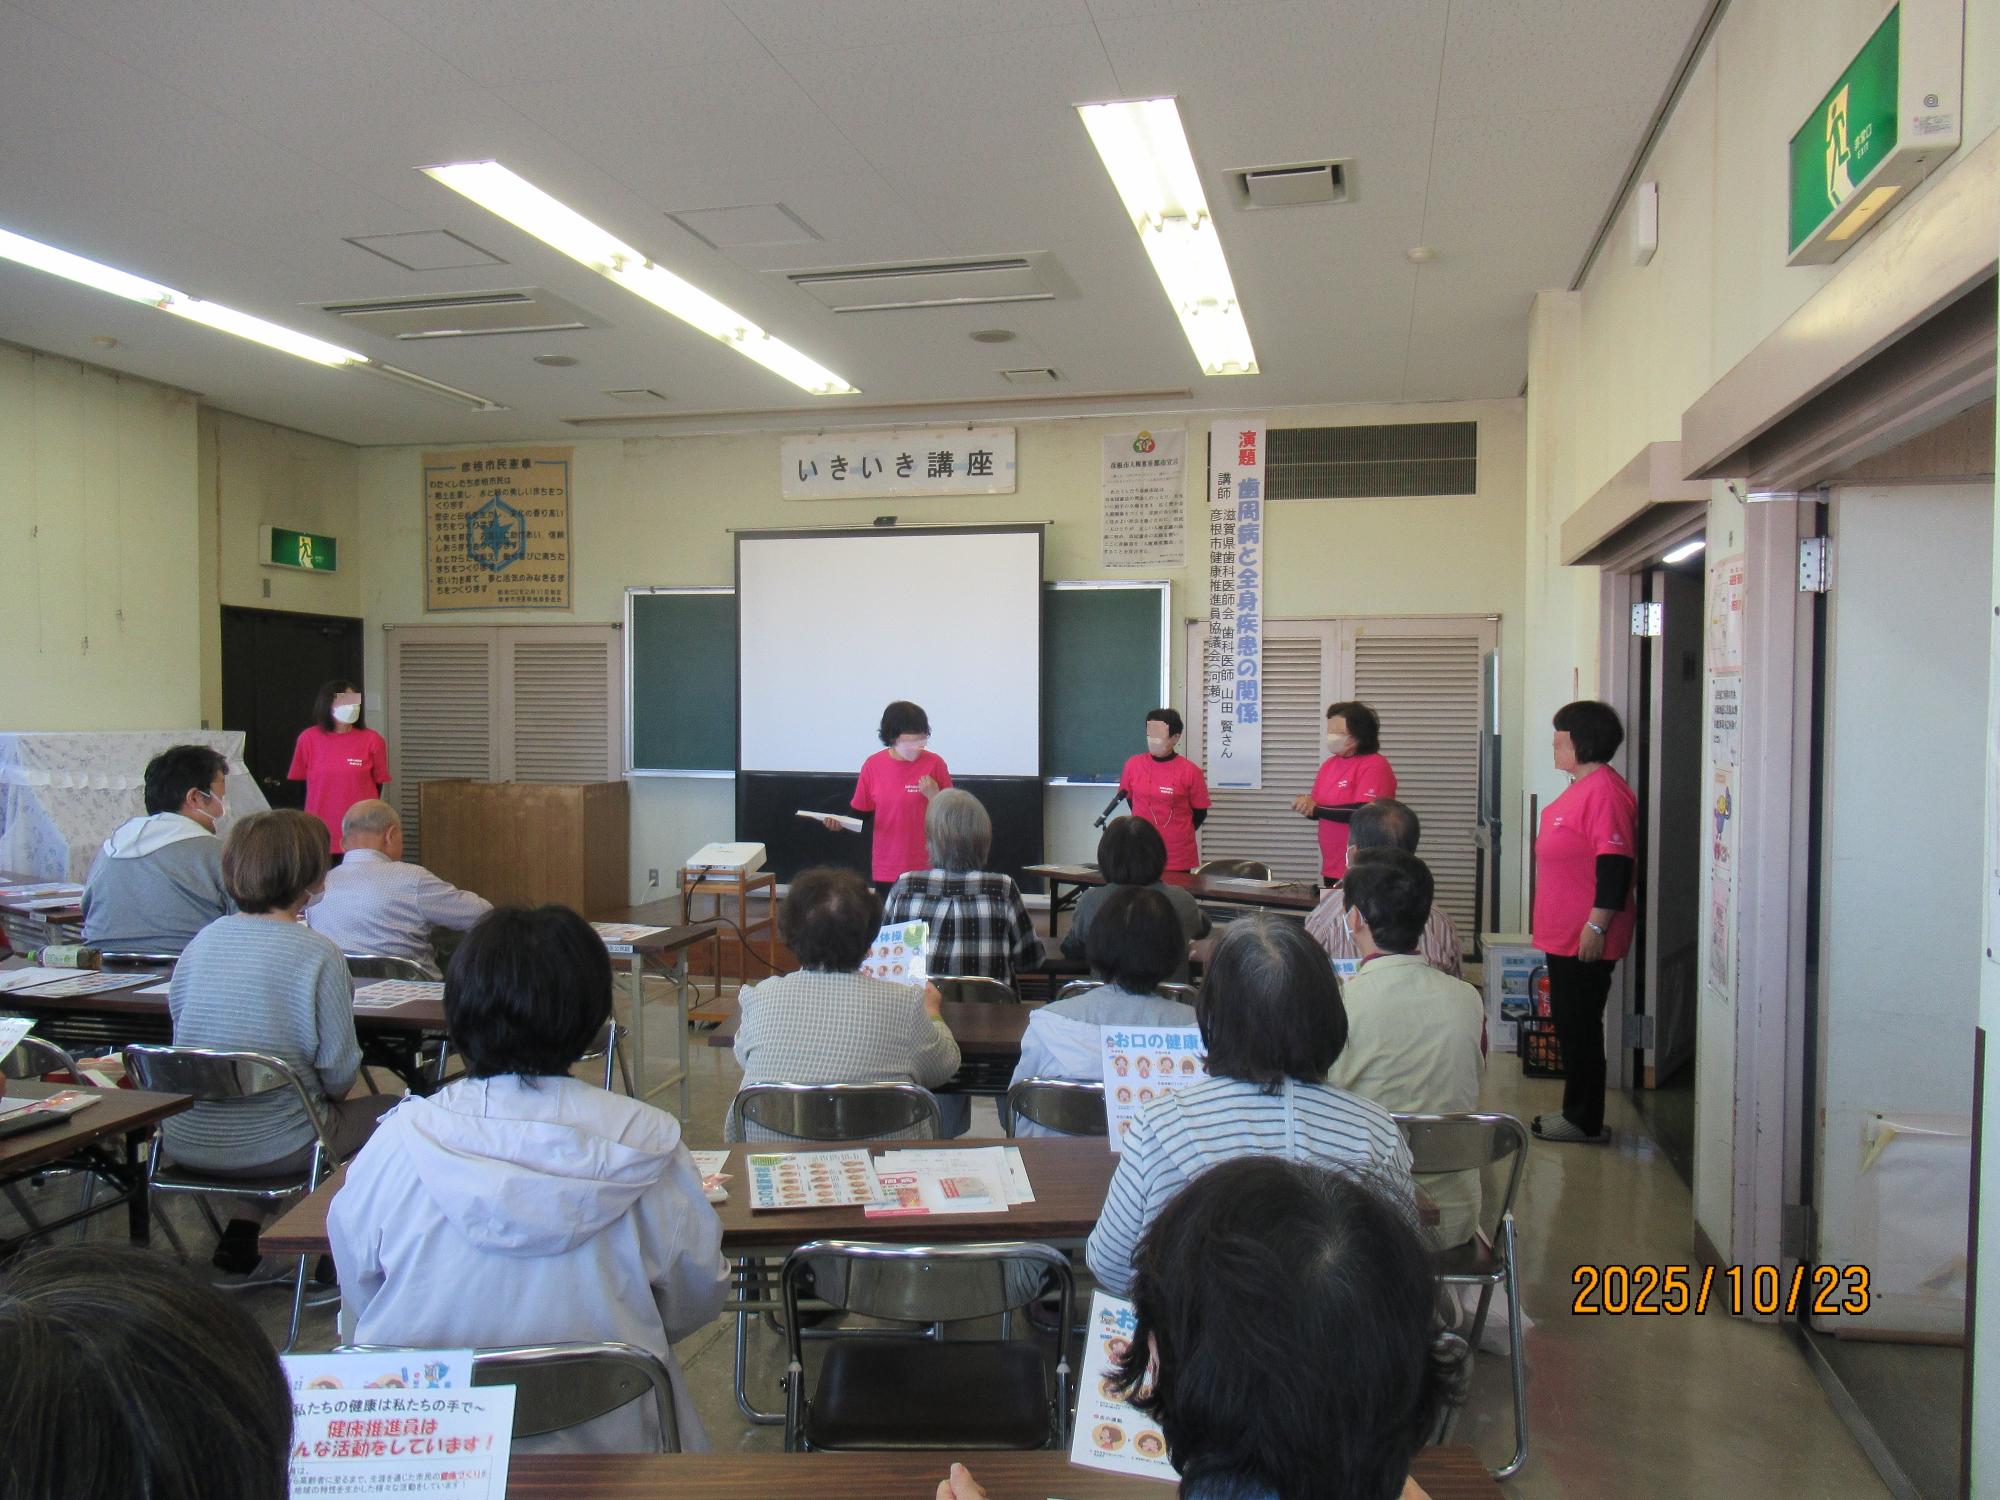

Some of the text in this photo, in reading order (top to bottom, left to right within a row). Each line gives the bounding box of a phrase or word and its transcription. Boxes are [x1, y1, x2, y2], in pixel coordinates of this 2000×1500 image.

[798, 450, 994, 481] いきいき講座
[1217, 472, 1232, 499] 講師
[1236, 430, 1260, 724] 演題 歯周病と全身疾患の関係
[1220, 508, 1236, 759] 滋賀県歯科医師会 歯科医師 山田 賢さん
[1114, 1032, 1199, 1050] お口の健康
[327, 1418, 439, 1438] 健康推進員は
